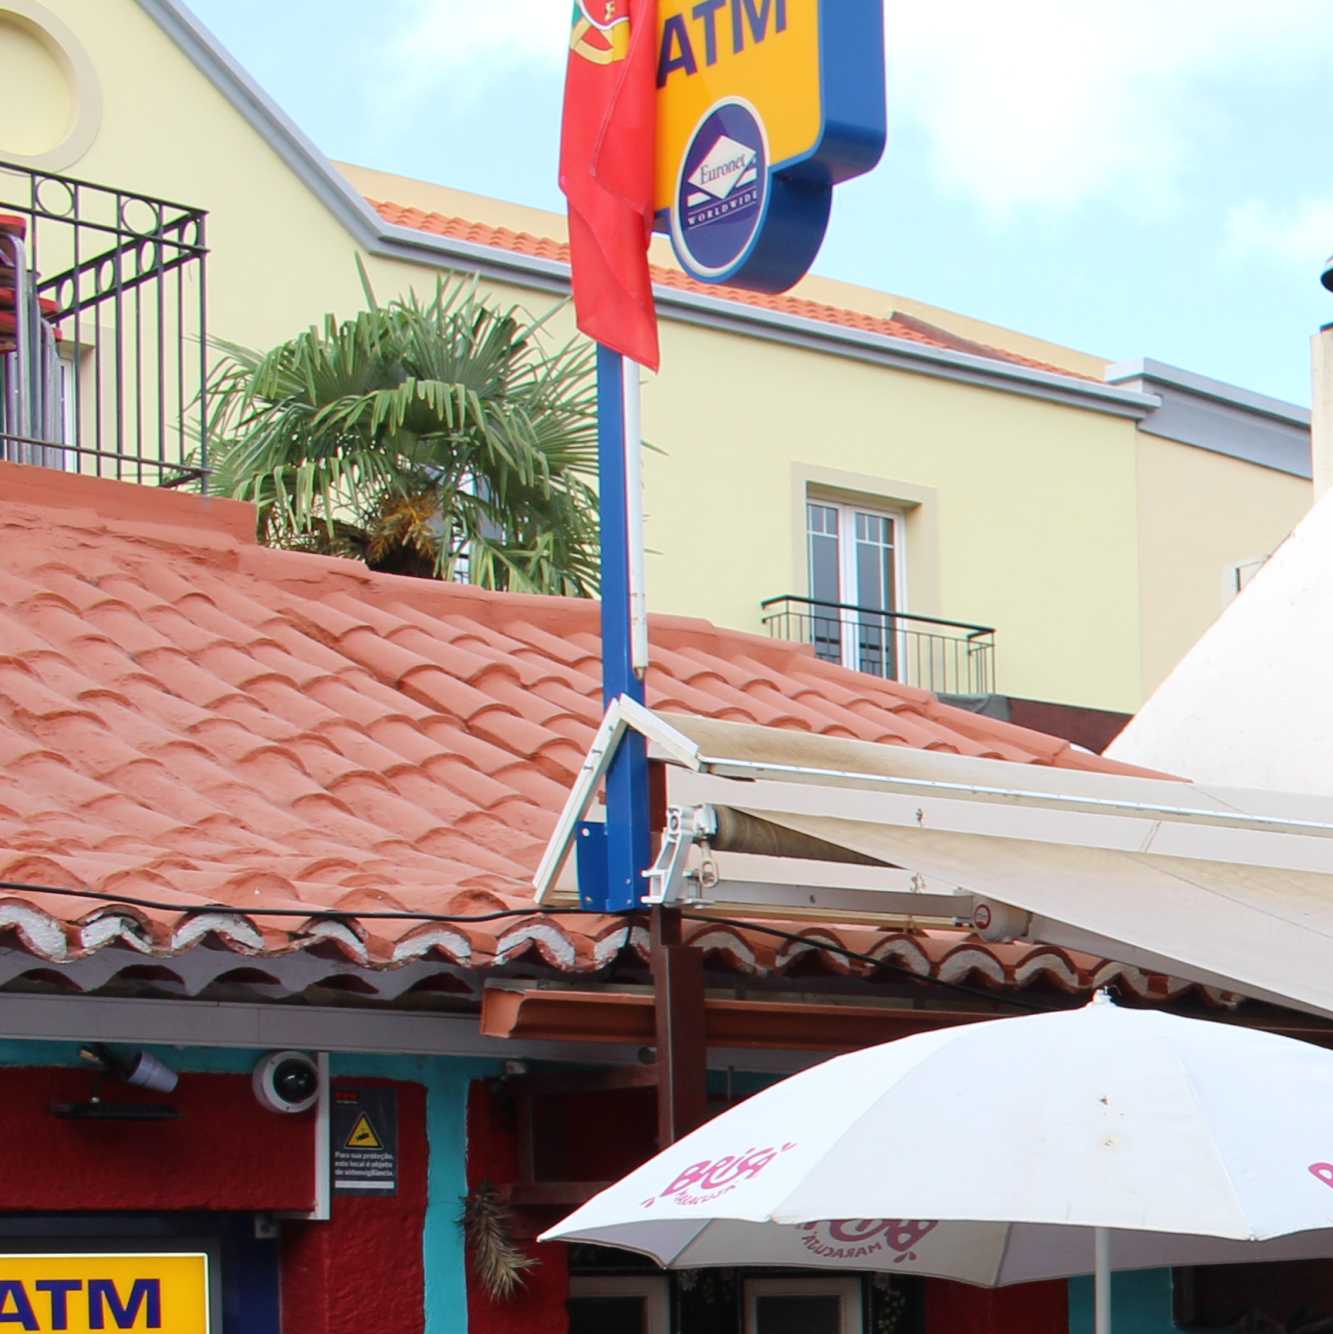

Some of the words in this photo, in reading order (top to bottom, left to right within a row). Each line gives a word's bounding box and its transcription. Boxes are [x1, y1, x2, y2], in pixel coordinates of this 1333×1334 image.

[656, 0, 788, 89] ATM
[700, 153, 746, 186] Euronet
[688, 190, 758, 226] WORLDWIDE
[0, 1278, 162, 1332] ATM
